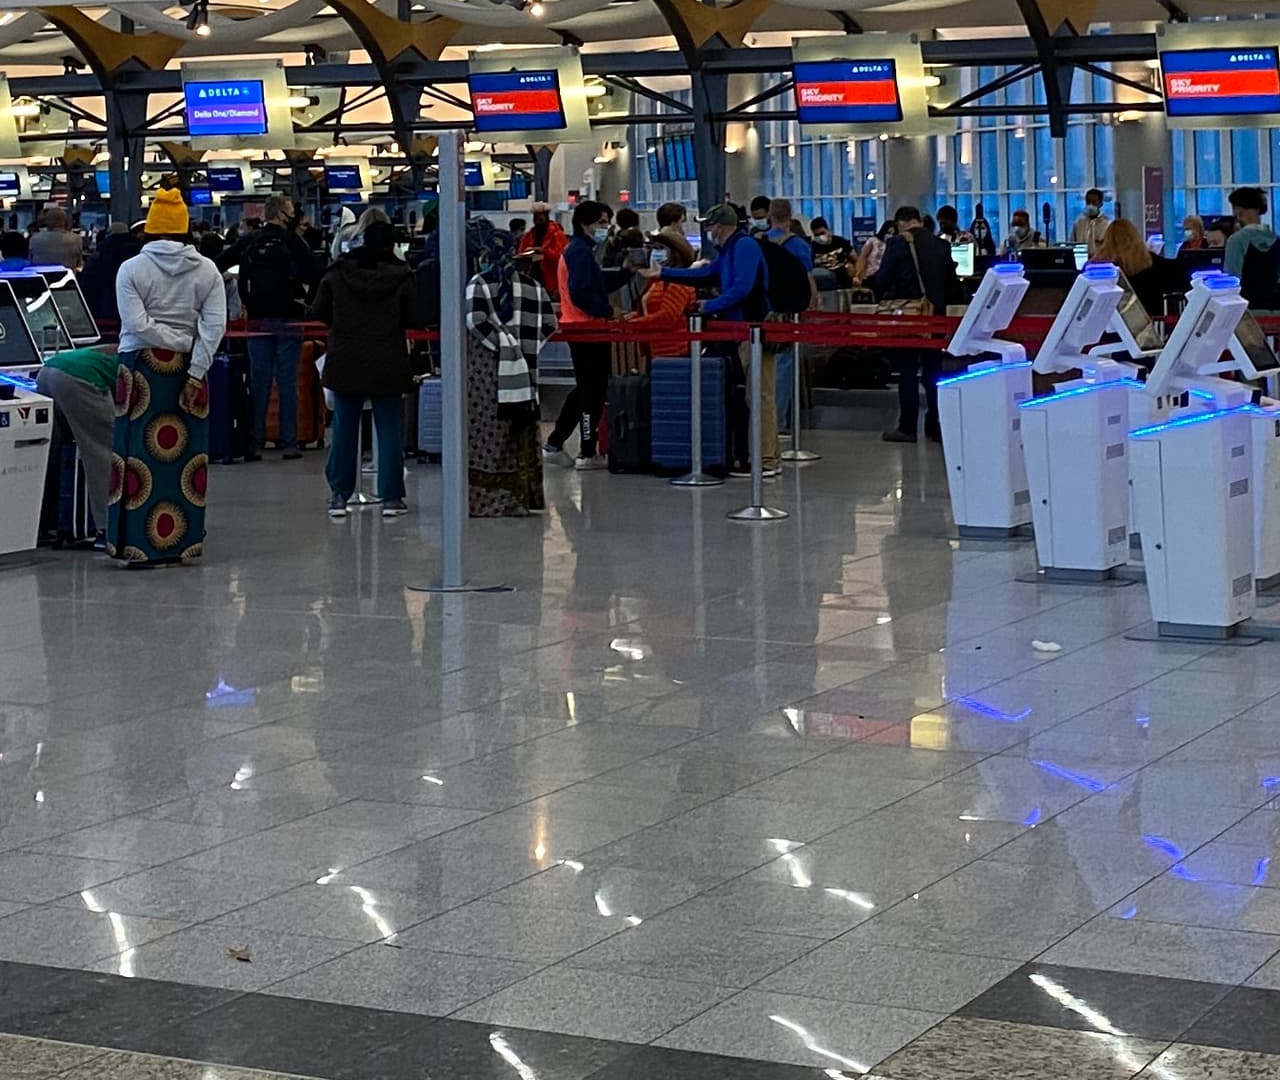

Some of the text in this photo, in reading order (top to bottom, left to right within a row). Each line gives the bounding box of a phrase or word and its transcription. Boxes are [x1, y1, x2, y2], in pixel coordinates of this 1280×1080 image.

[1237, 53, 1265, 62] DELTA
[208, 88, 240, 97] DELTA
[1171, 84, 1220, 94] PRIORITY
